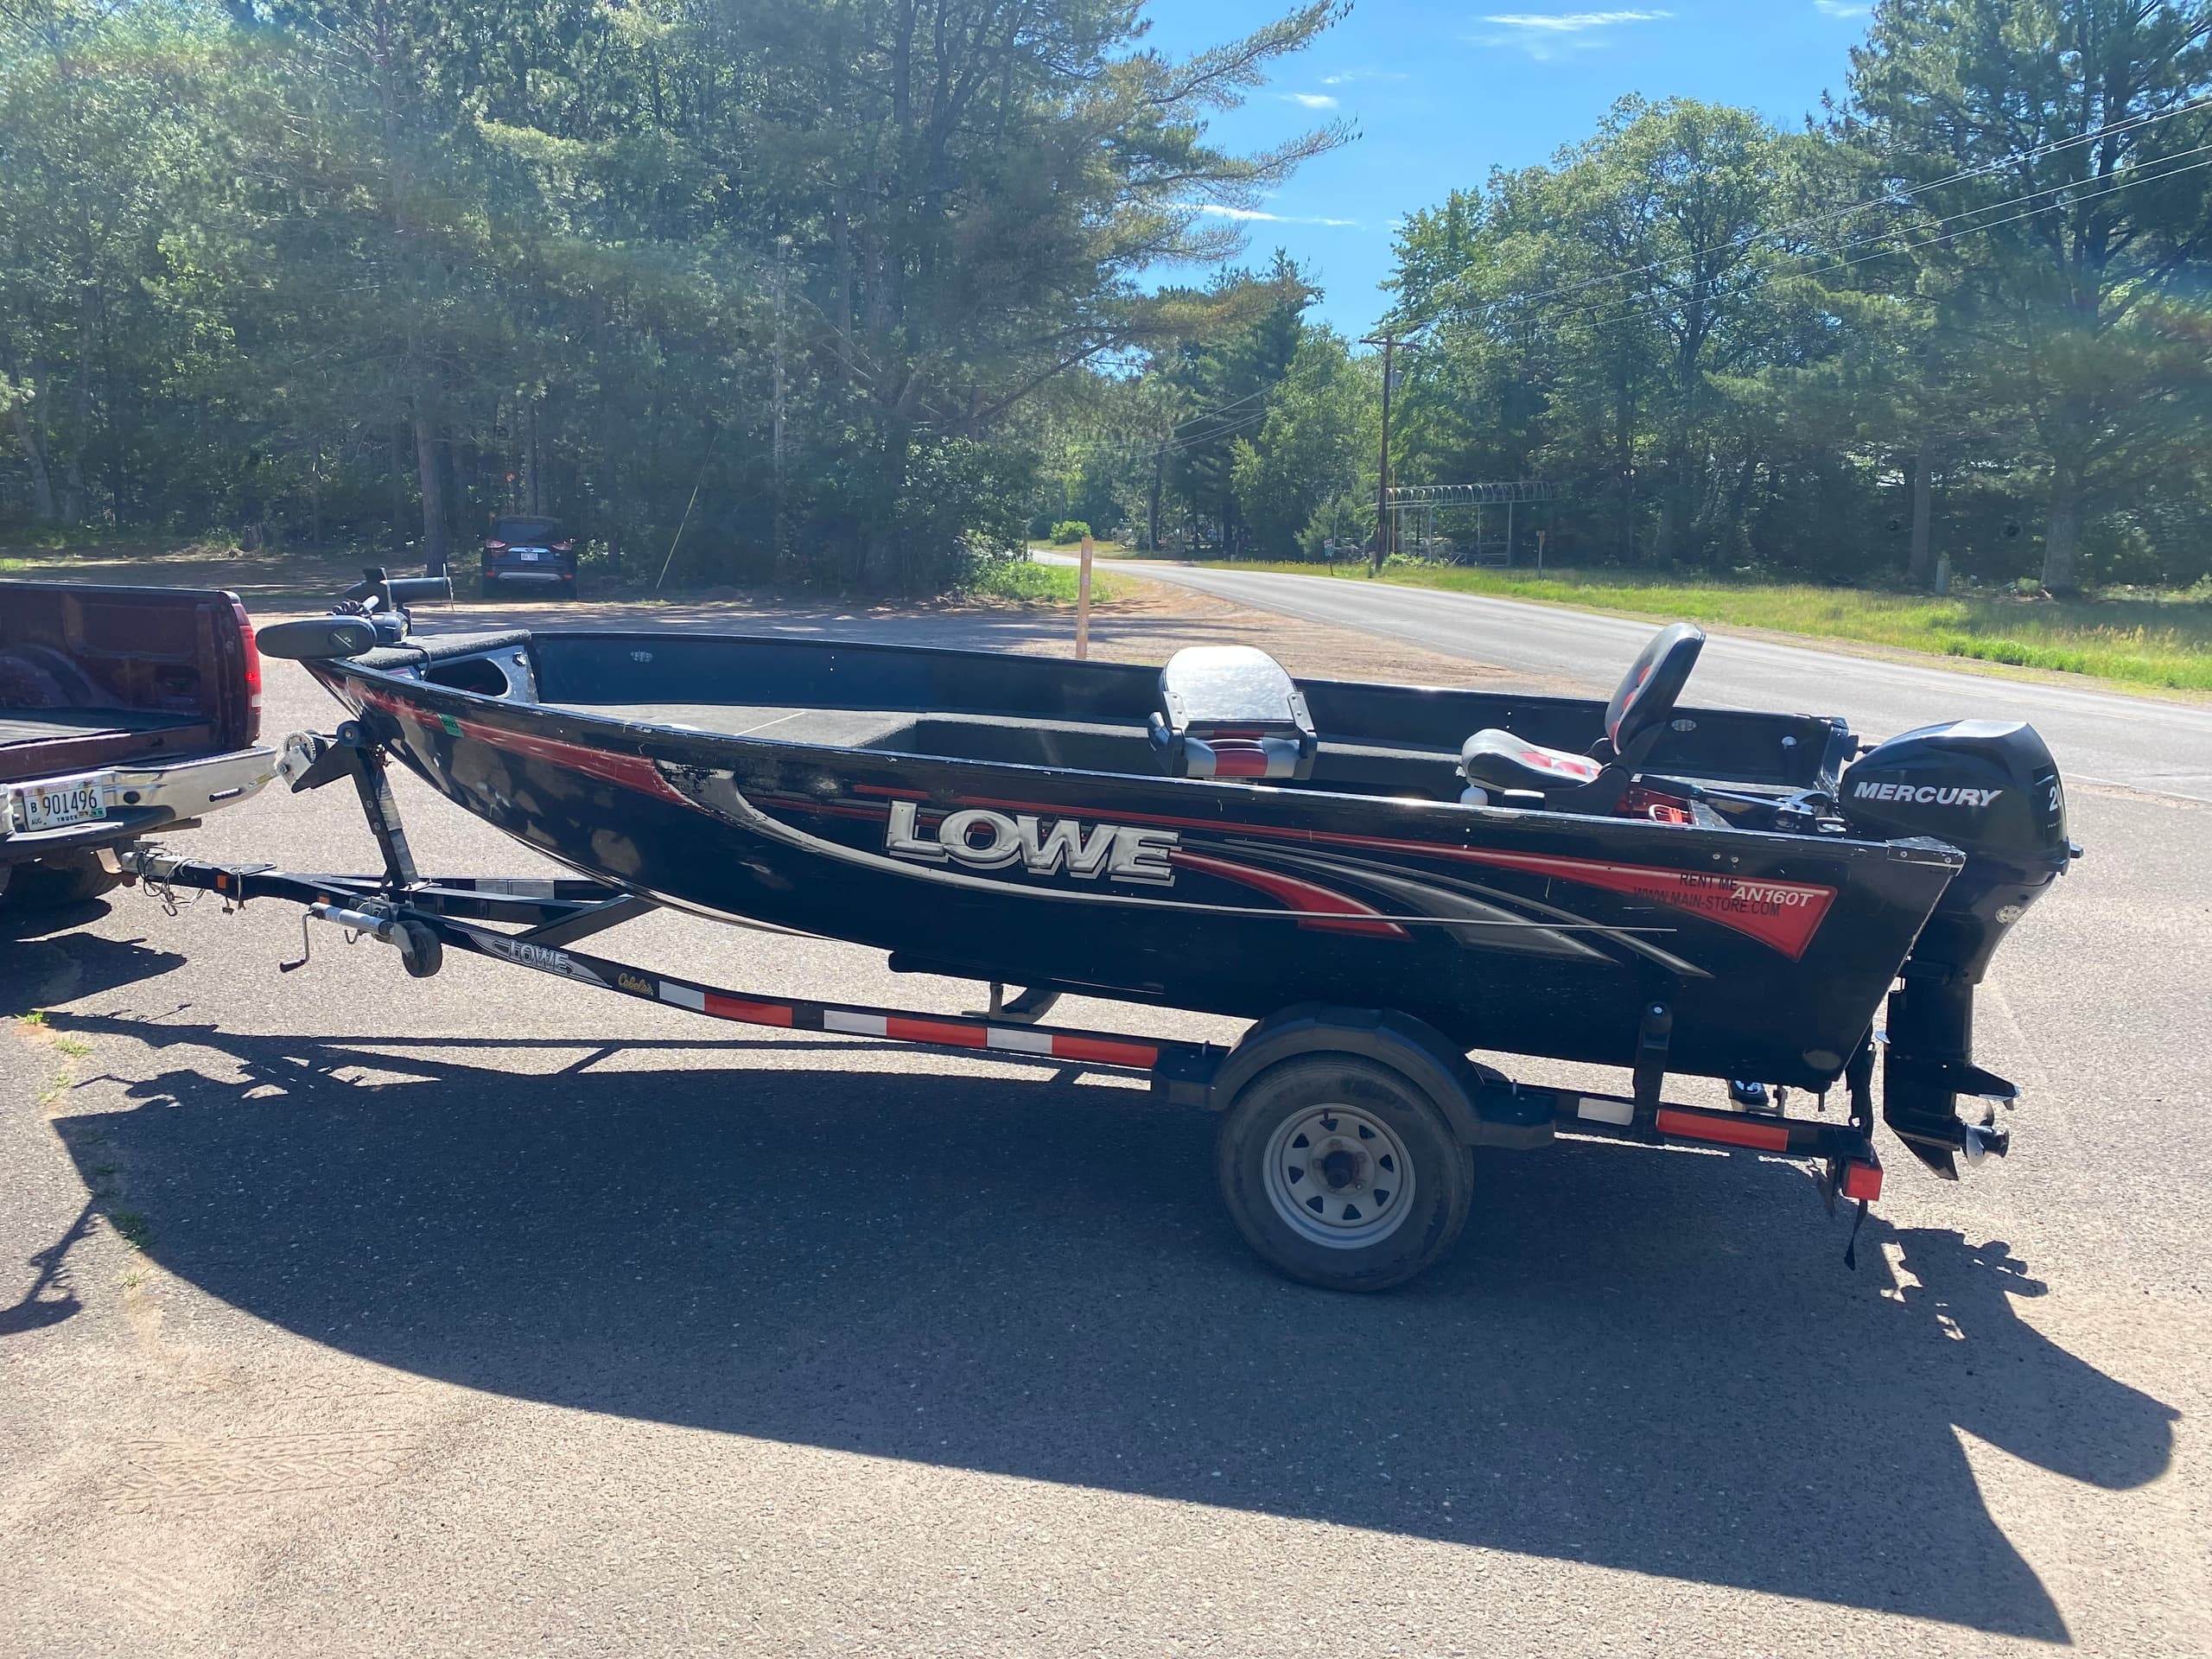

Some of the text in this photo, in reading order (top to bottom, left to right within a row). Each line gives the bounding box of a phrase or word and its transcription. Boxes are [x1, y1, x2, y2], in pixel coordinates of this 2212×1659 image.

[30, 802, 37, 813] B
[42, 789, 98, 817] 901496
[1853, 781, 2004, 807] MERCURY
[31, 817, 42, 826] AUG
[884, 799, 1181, 886] LOWE
[1679, 872, 1738, 892] RENT ME
[1732, 886, 1814, 907] AN160T
[507, 939, 570, 973] LOWE
